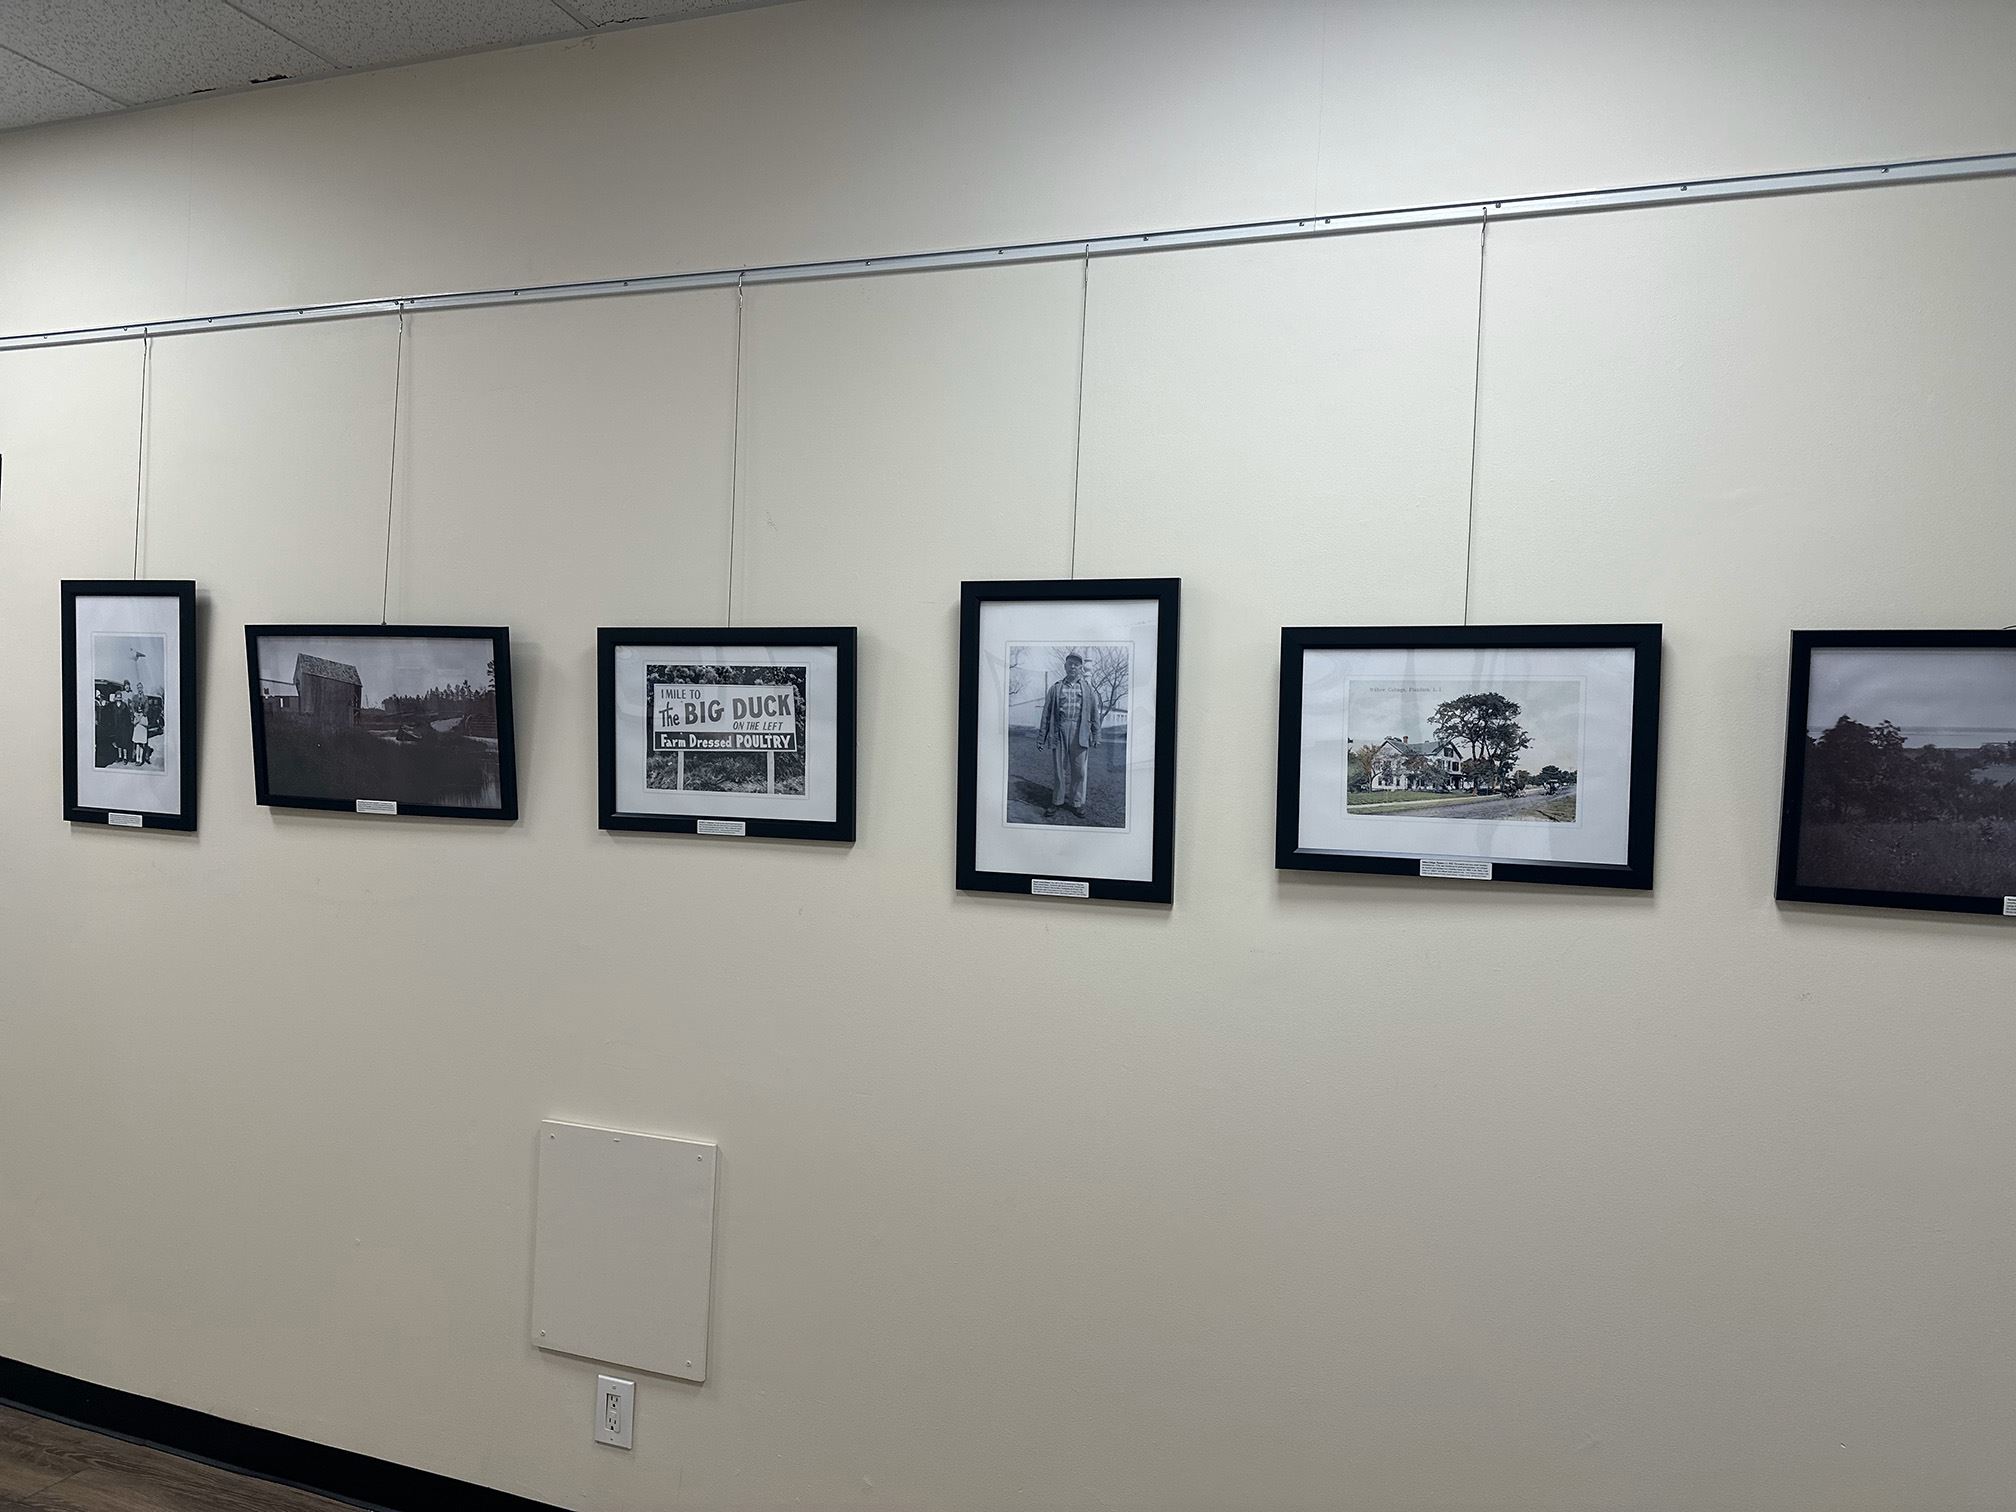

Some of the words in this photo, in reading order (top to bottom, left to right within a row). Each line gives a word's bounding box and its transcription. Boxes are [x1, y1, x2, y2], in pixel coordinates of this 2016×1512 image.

[665, 689, 687, 699] MILE
[690, 689, 701, 699] TO
[685, 700, 724, 725] BIG
[732, 694, 791, 720] DUCK
[733, 722, 744, 730] ON
[746, 722, 759, 731] THE
[762, 722, 783, 731] LEFT
[660, 734, 686, 748] Farm
[689, 734, 732, 748] Dressed
[735, 734, 791, 749] POULTRY
